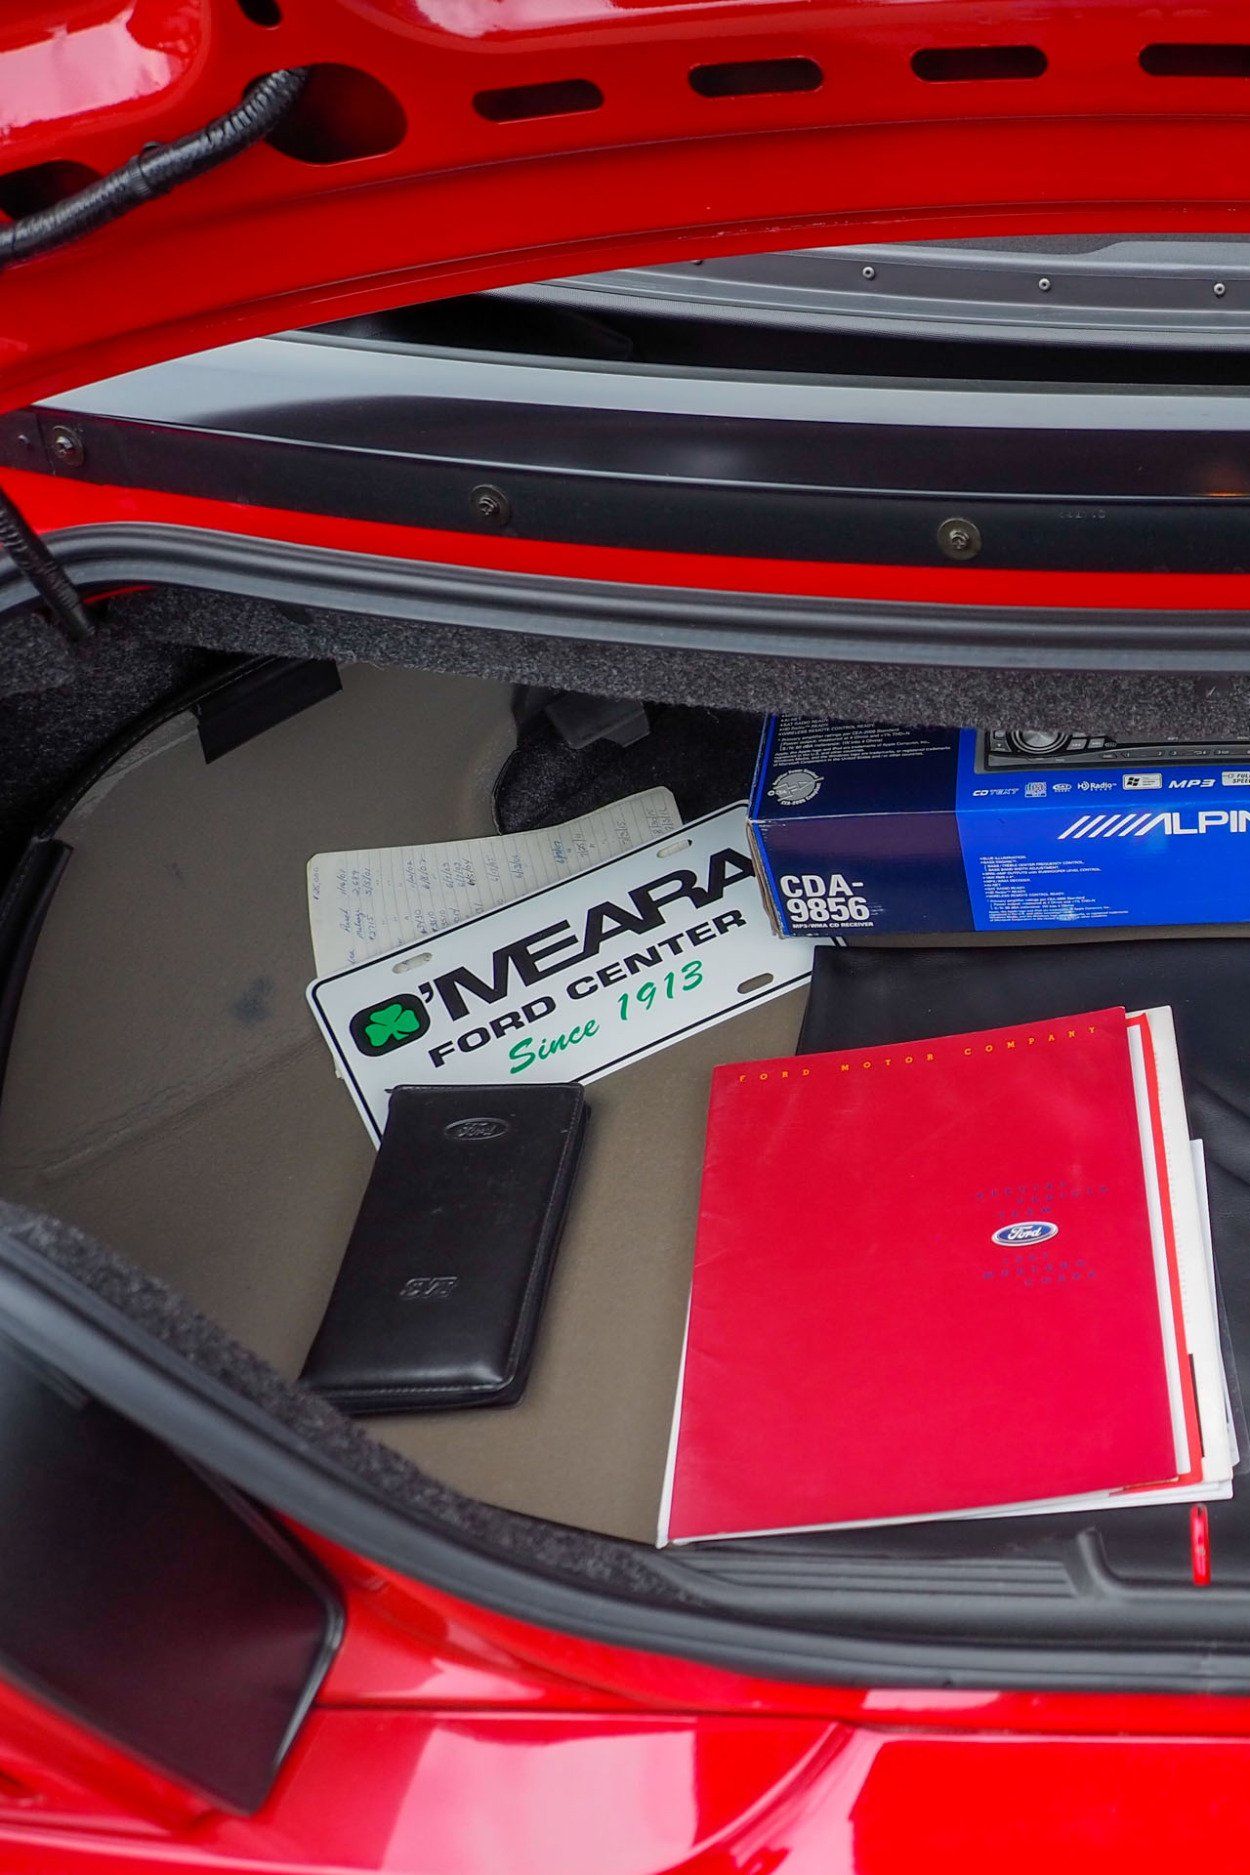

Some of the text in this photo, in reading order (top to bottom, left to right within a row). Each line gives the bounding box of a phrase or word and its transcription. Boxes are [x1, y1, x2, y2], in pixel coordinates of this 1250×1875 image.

[972, 789, 989, 797] CD
[1168, 779, 1216, 789] MP3
[780, 874, 864, 898] CDA-
[786, 896, 870, 922] 9856
[428, 908, 747, 1068] FORD CENTER
[508, 960, 704, 1075] Since 1913
[738, 1025, 1099, 1083] FORD MOTOR COMPANY
